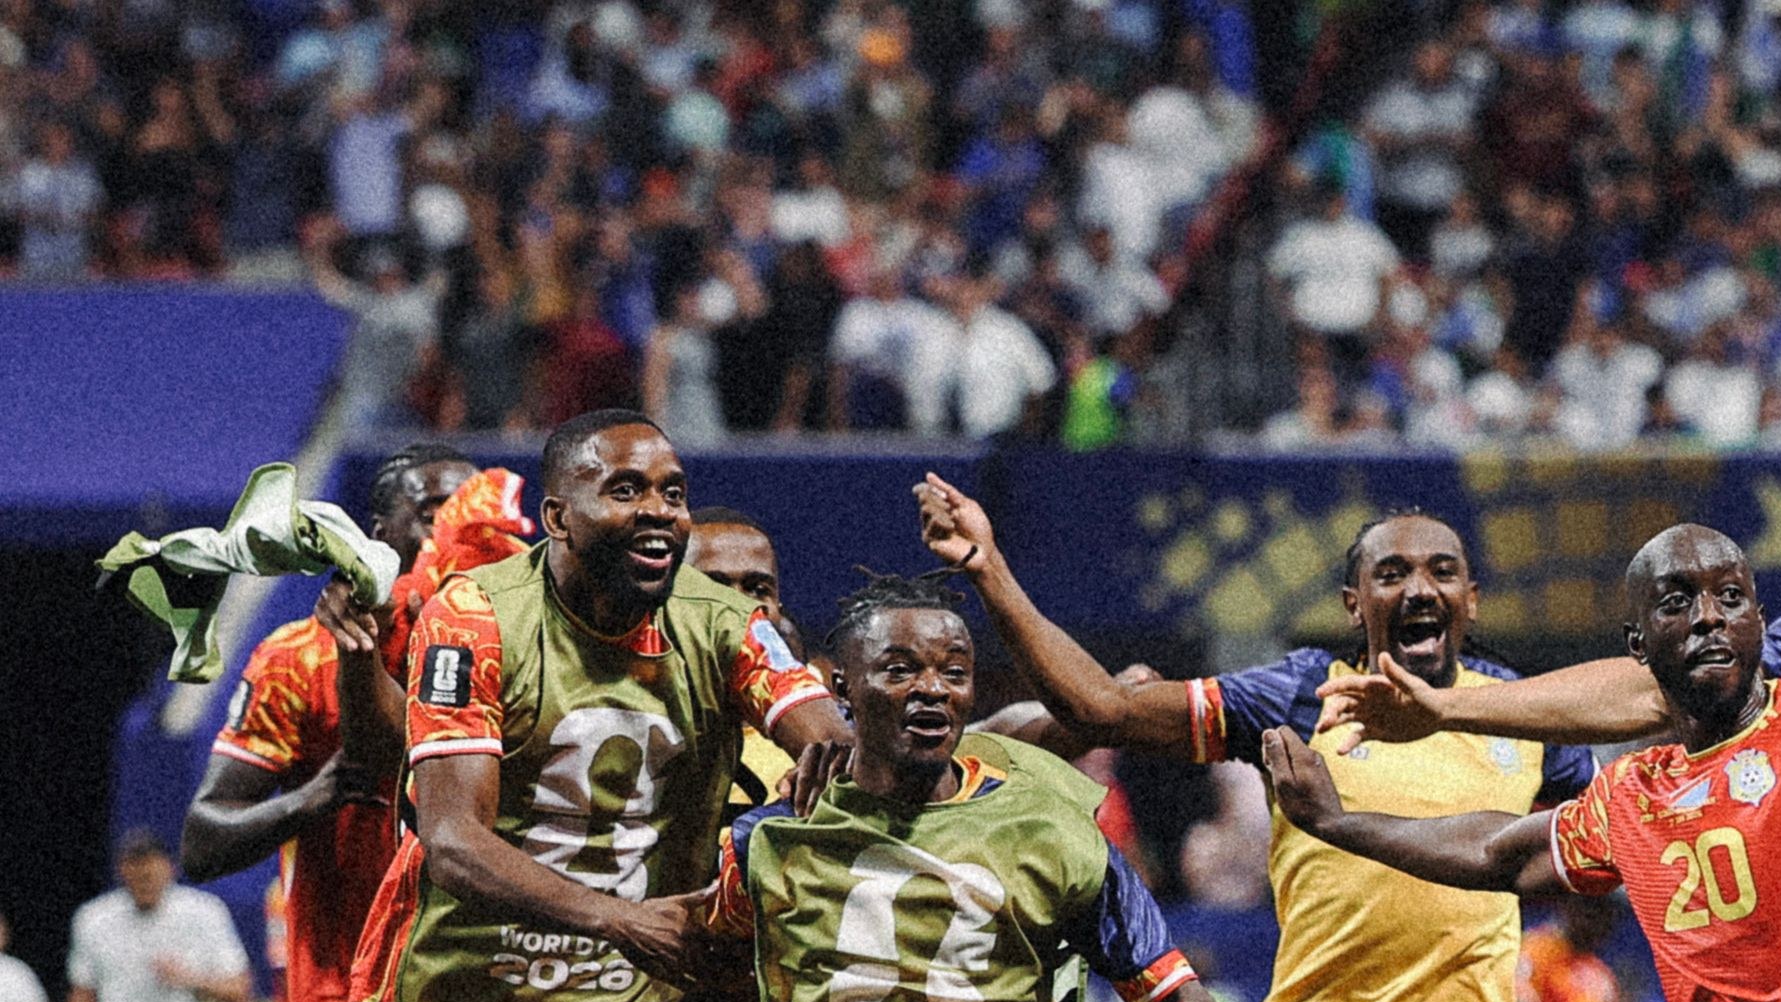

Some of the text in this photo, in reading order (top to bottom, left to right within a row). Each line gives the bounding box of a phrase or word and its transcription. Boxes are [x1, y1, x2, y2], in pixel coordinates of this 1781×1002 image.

[1660, 826, 1758, 933] 20
[500, 925, 594, 956] WORLD
[489, 953, 635, 991] 2026
